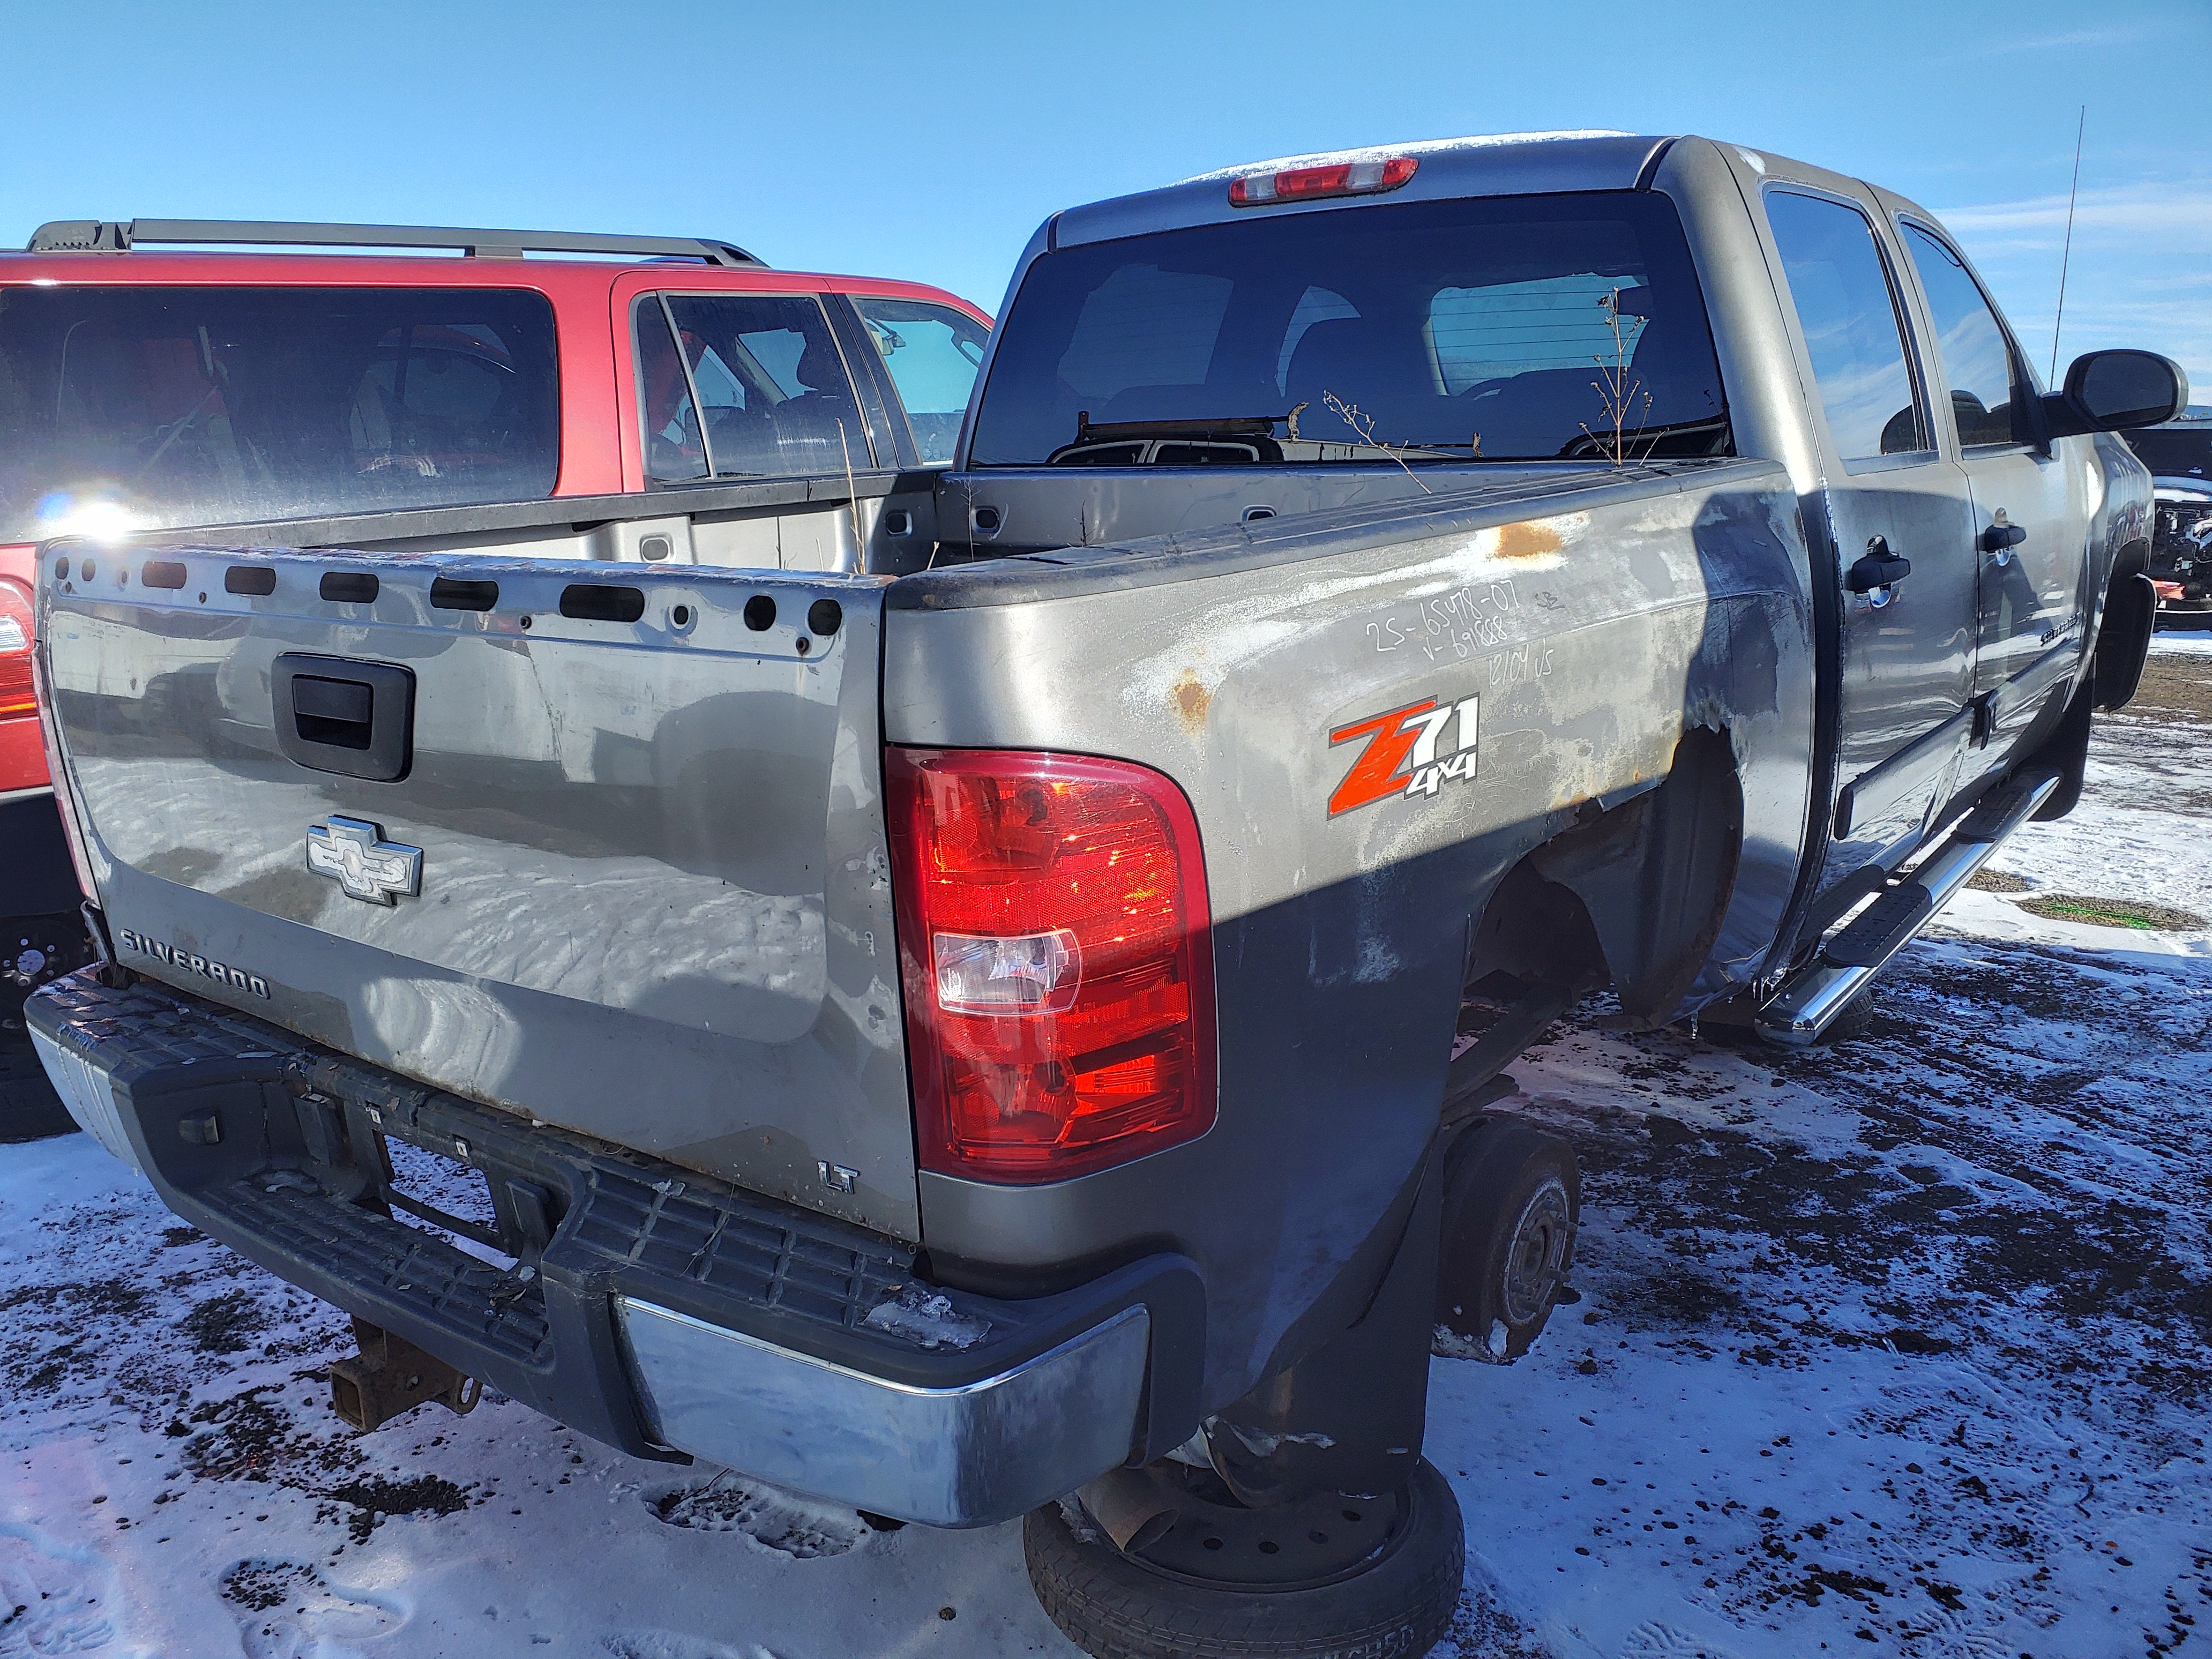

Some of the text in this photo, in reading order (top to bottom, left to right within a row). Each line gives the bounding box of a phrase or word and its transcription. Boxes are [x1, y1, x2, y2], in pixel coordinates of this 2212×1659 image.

[1328, 691, 1479, 819] Z71
[120, 928, 271, 1000] SILVERADO
[817, 1160, 860, 1194] LT
